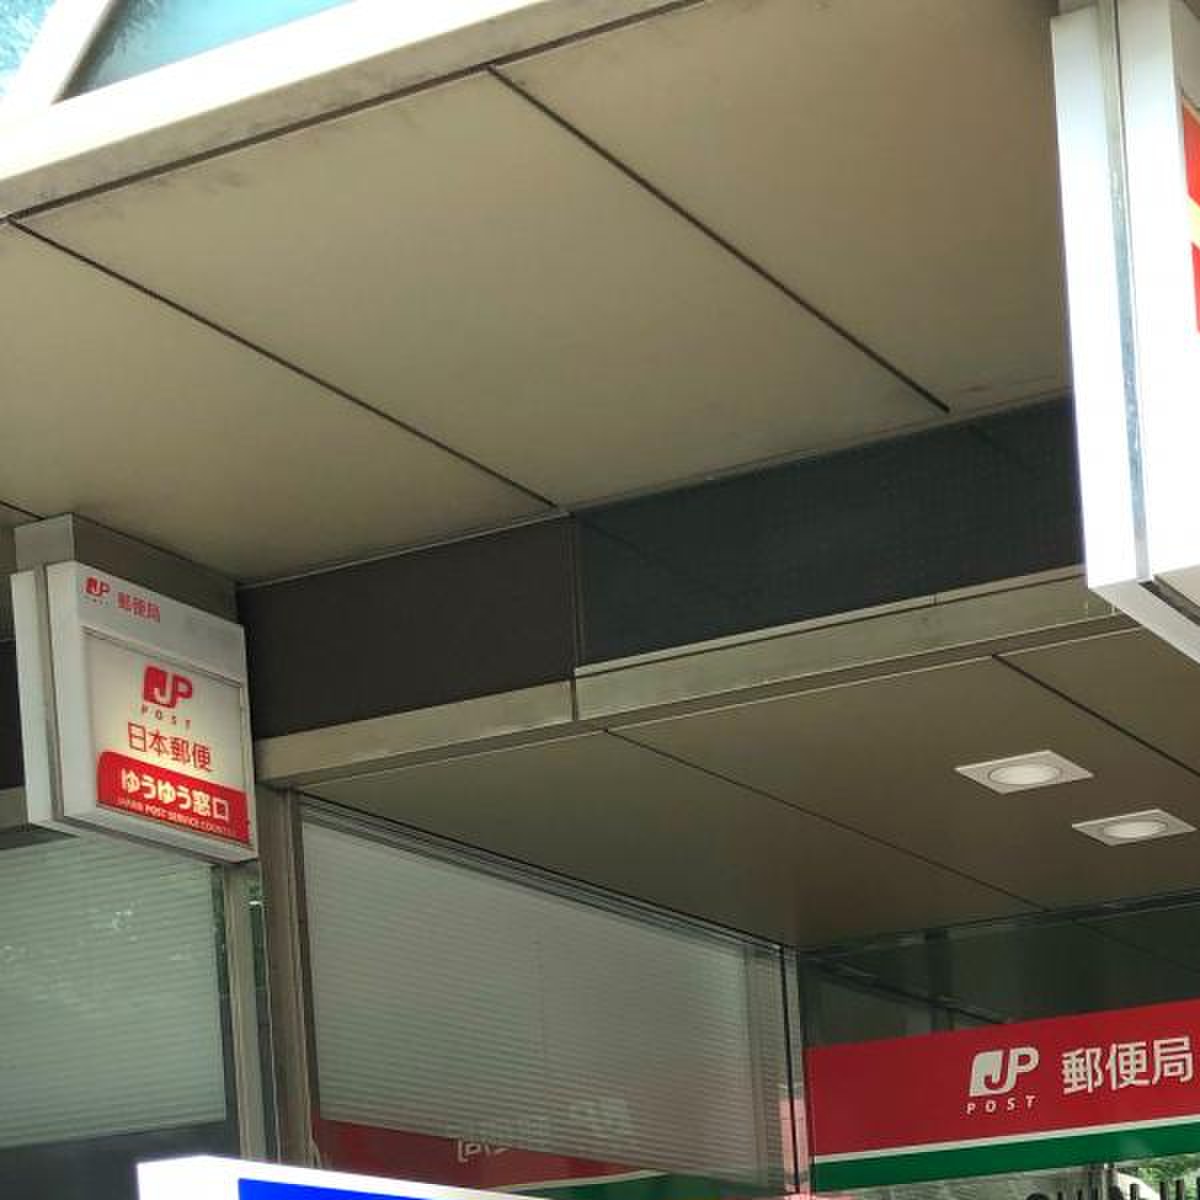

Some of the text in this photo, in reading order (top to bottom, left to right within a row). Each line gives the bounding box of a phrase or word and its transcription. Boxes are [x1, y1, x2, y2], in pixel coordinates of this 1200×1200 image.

[141, 705, 191, 730] POST
[127, 721, 213, 773] 日本郵便
[121, 767, 229, 822] ゆうゆう窓口
[969, 1047, 1039, 1097] JP
[1061, 1036, 1194, 1095] 郵便局
[966, 1095, 1035, 1115] POST
